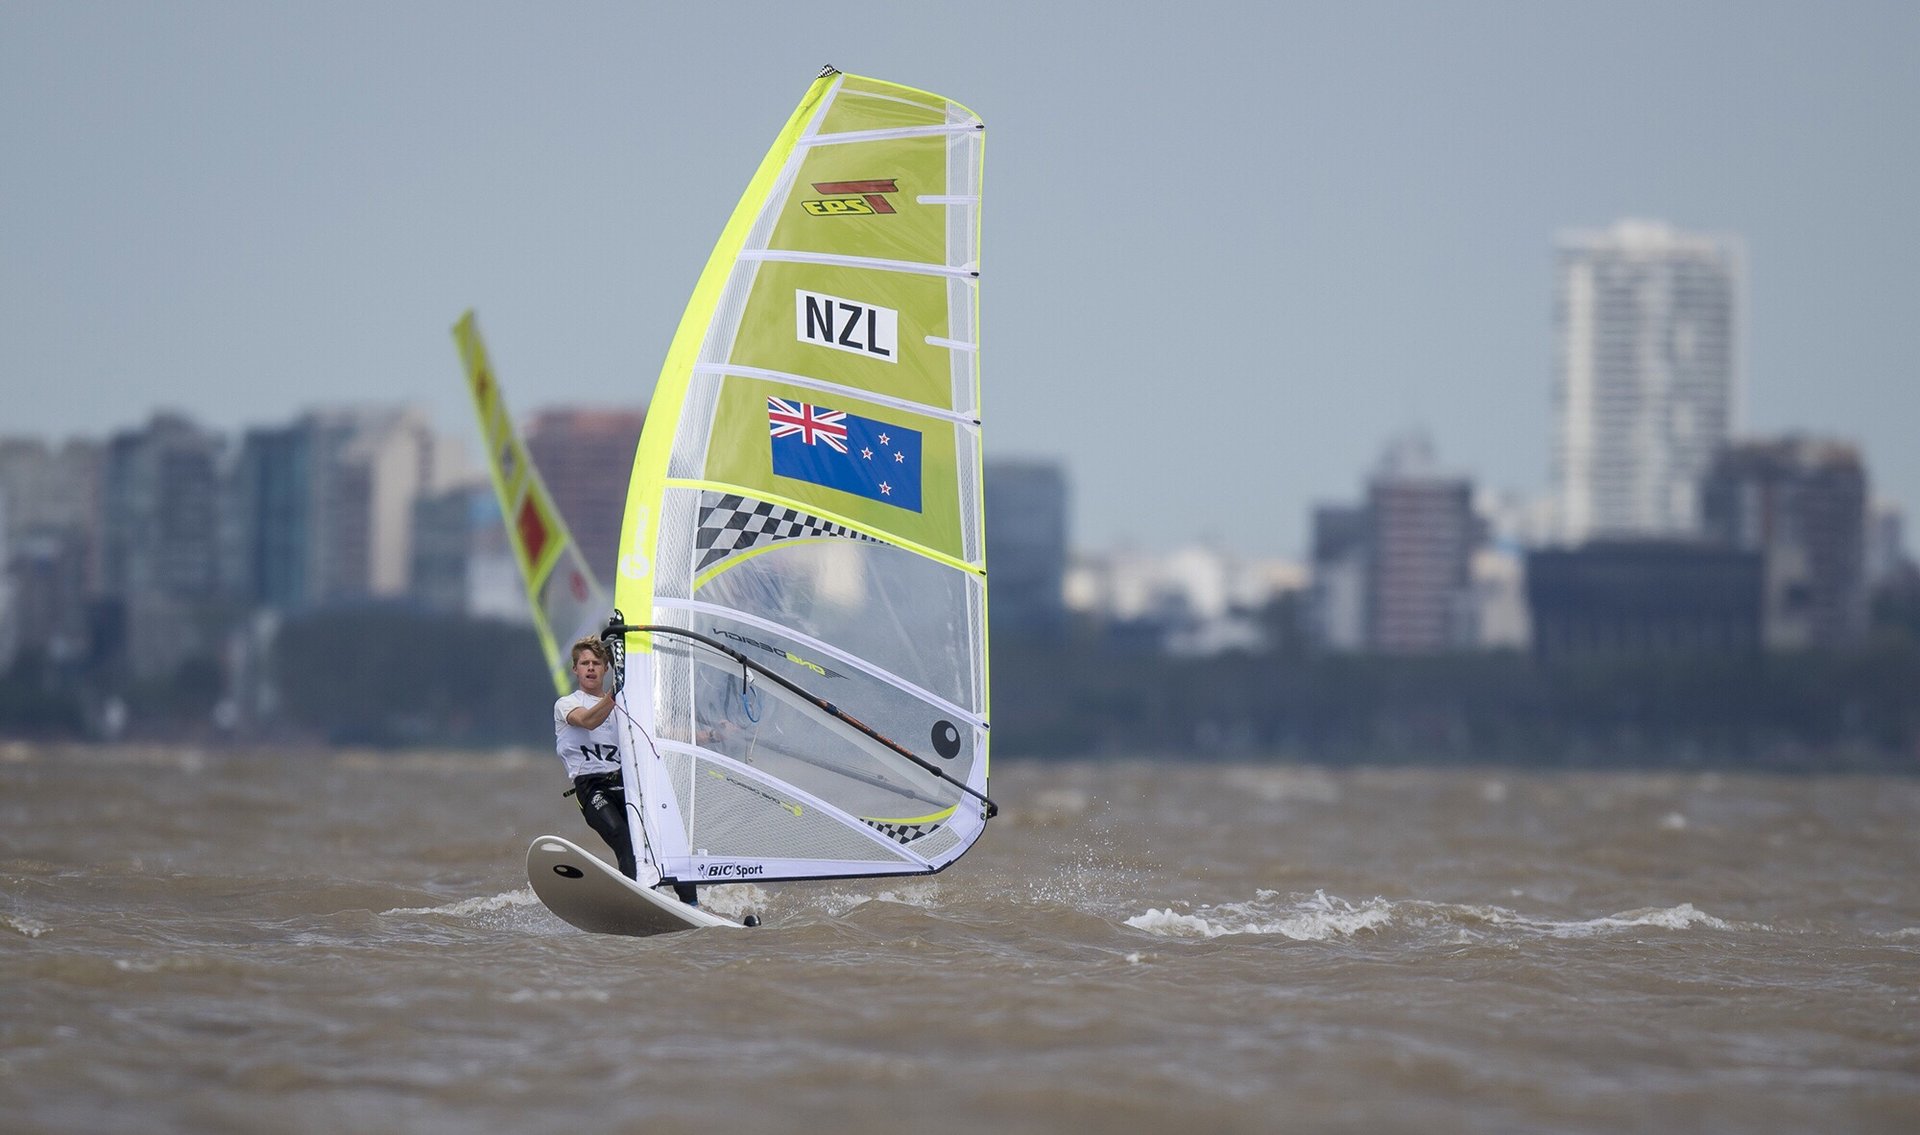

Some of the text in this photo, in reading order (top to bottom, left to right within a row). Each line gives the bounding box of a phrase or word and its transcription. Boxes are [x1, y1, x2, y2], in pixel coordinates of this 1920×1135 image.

[805, 295, 890, 357] NZL
[580, 743, 621, 765] NZ
[736, 864, 763, 878] Sport
